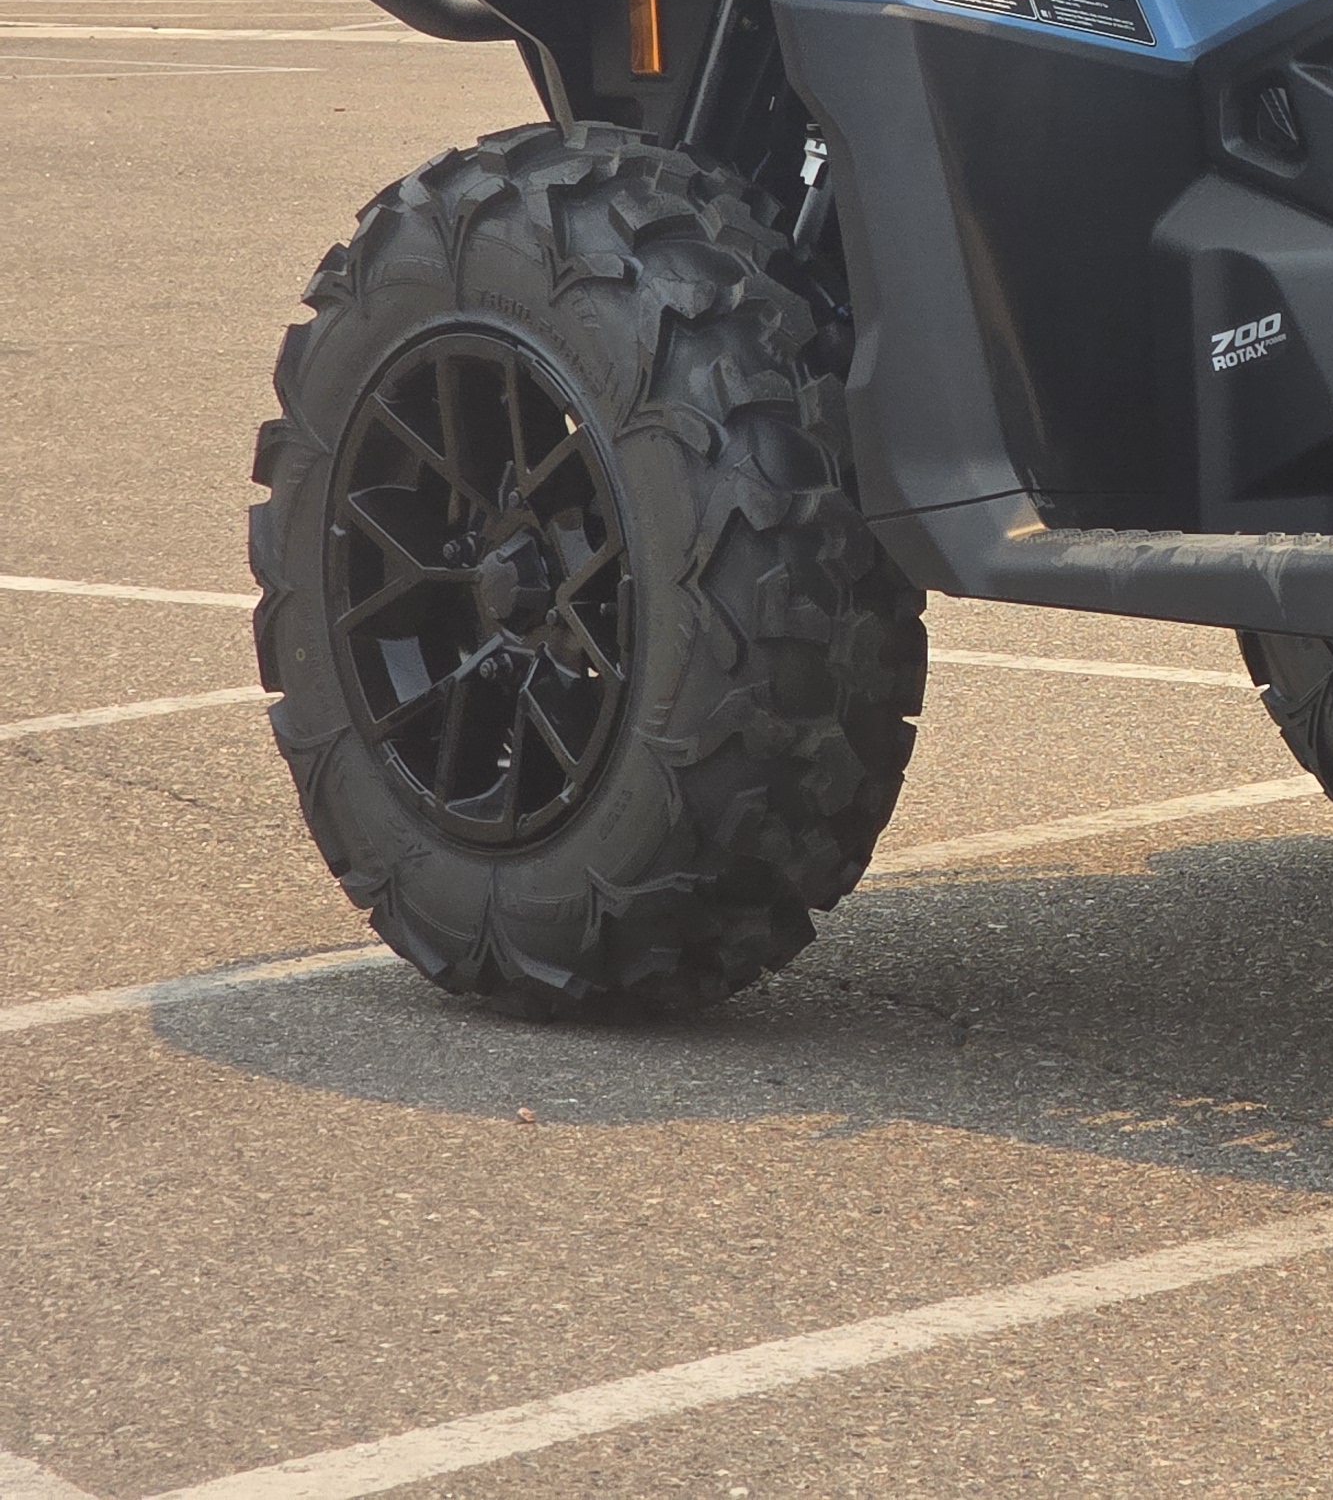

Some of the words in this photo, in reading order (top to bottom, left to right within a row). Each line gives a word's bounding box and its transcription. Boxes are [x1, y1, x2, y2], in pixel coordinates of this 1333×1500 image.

[1211, 312, 1282, 355] 700
[1211, 340, 1269, 372] ROTAX
[1264, 333, 1288, 347] POWER
